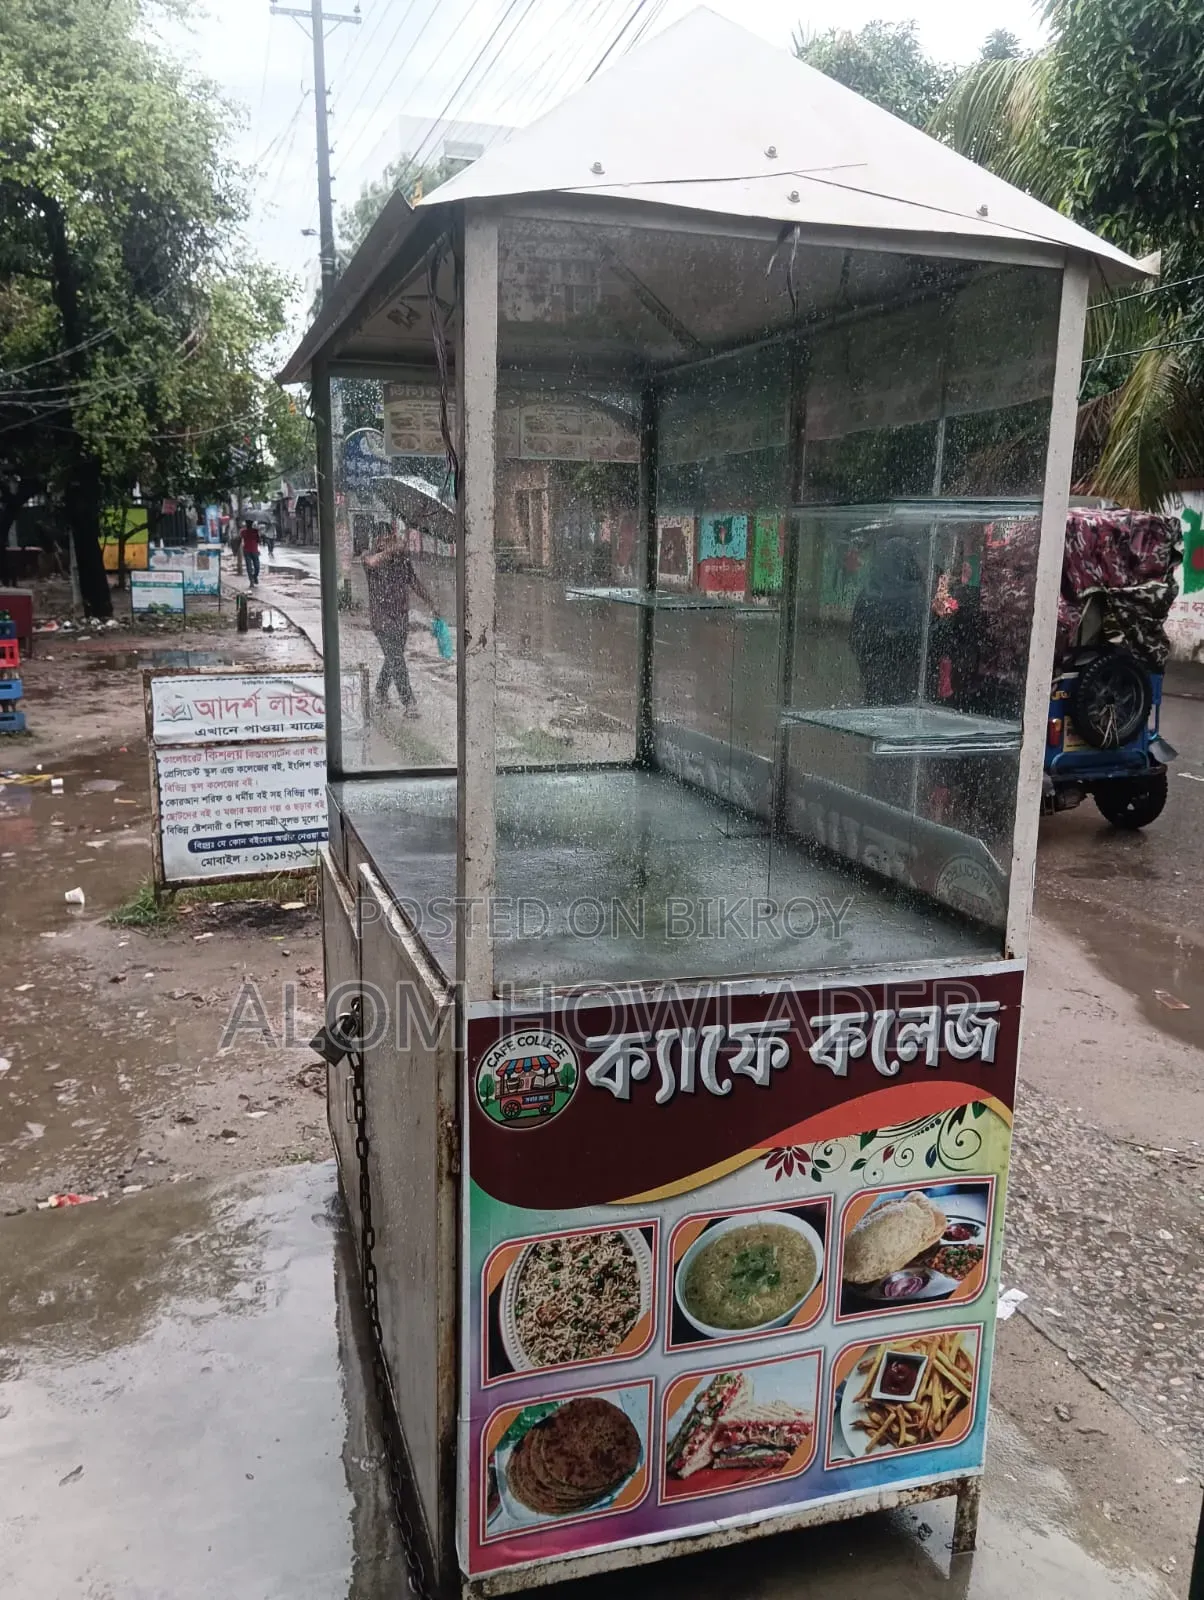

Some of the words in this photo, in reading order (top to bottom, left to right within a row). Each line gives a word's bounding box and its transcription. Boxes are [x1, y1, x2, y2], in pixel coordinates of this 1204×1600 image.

[192, 688, 262, 720] আদর্শ
[195, 726, 239, 736] এখানে
[244, 723, 285, 733] পাওয়া
[201, 854, 241, 867] মোবাইল
[486, 1040, 516, 1068] CAFE
[517, 1034, 569, 1060] COLLEGE
[585, 1019, 791, 1104] ক্যাফে
[808, 1001, 1001, 1077] কলেজ
